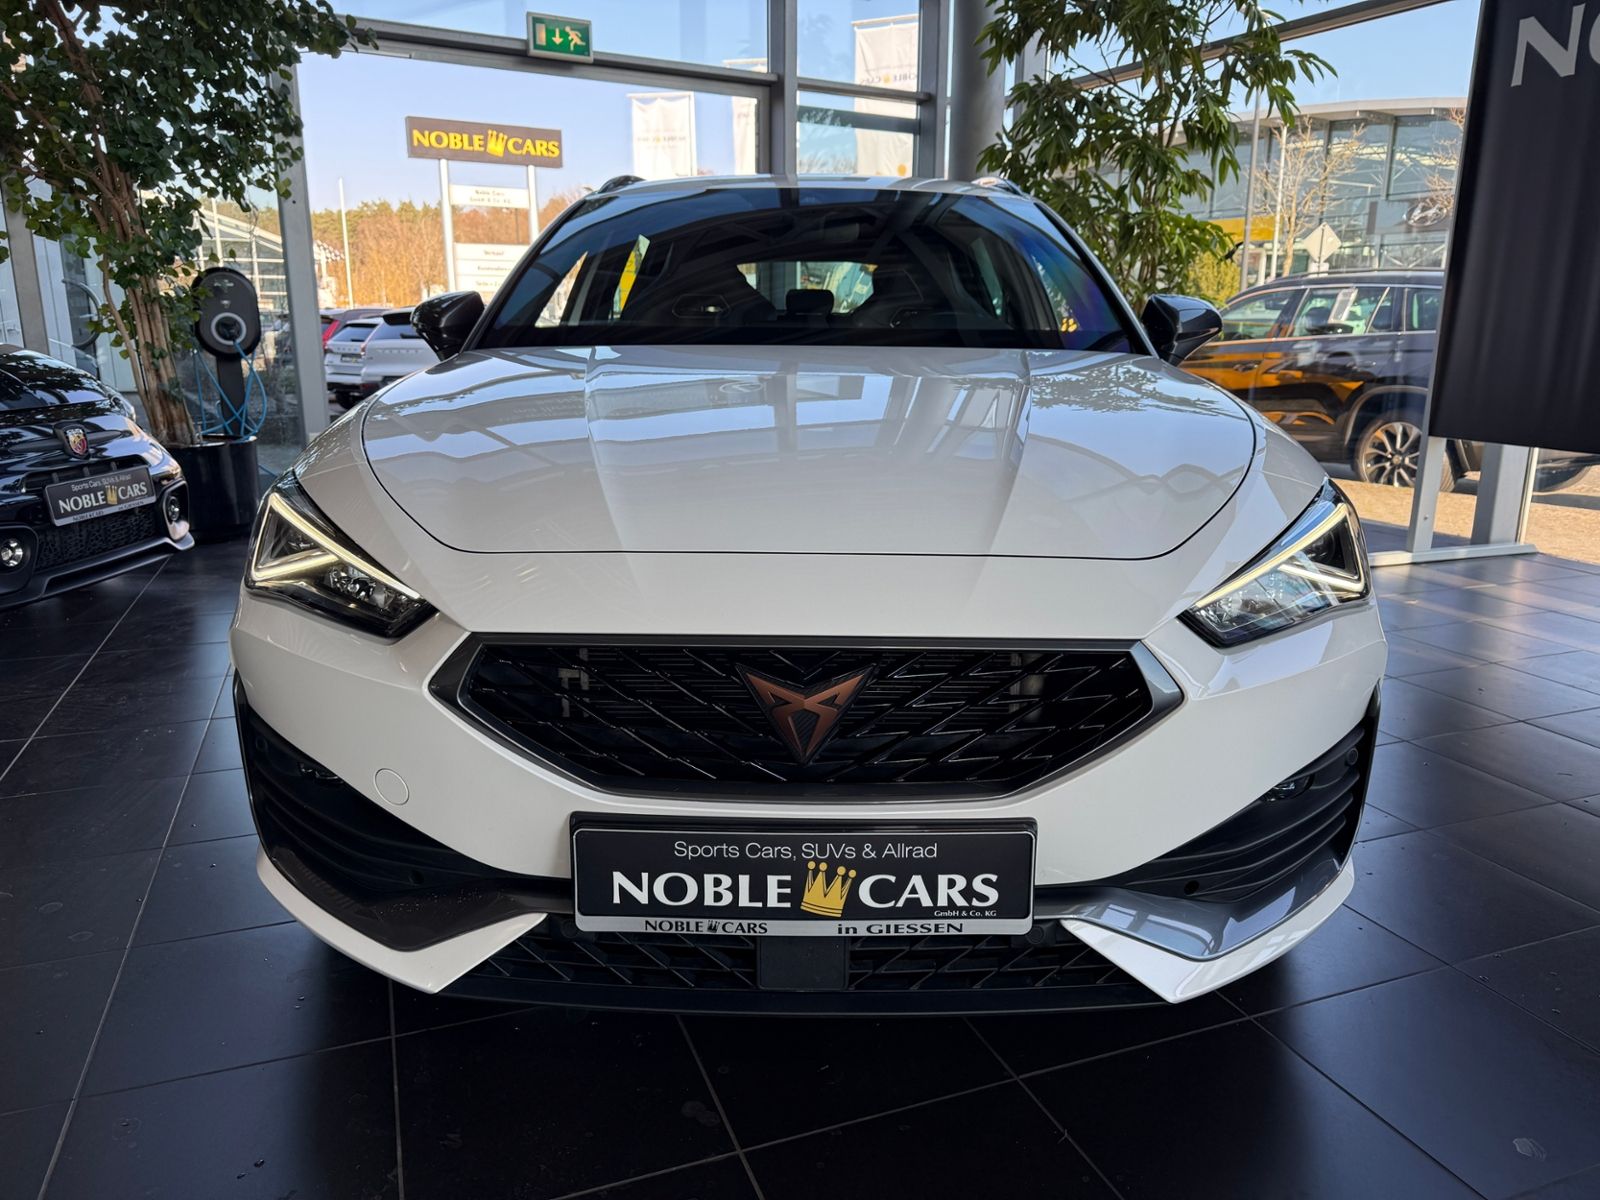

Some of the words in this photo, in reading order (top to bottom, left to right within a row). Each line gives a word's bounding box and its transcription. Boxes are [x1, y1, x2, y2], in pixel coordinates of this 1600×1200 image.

[1510, 3, 1600, 87] N
[412, 129, 485, 152] NOBLE
[507, 137, 561, 158] CARS
[58, 490, 106, 514] NOBLE
[118, 482, 148, 500] CARS
[674, 840, 740, 860] Sports
[745, 842, 797, 861] Cars,
[801, 842, 857, 859] SUVs
[862, 843, 877, 859] &
[882, 842, 938, 859] Allrad
[612, 871, 792, 908] NOBLE
[858, 873, 999, 909] CARS
[934, 909, 960, 917] GmbH
[644, 919, 704, 933] NOBLE
[721, 921, 768, 934] CARS
[837, 923, 858, 934] in
[866, 922, 964, 934] GIESSEN
